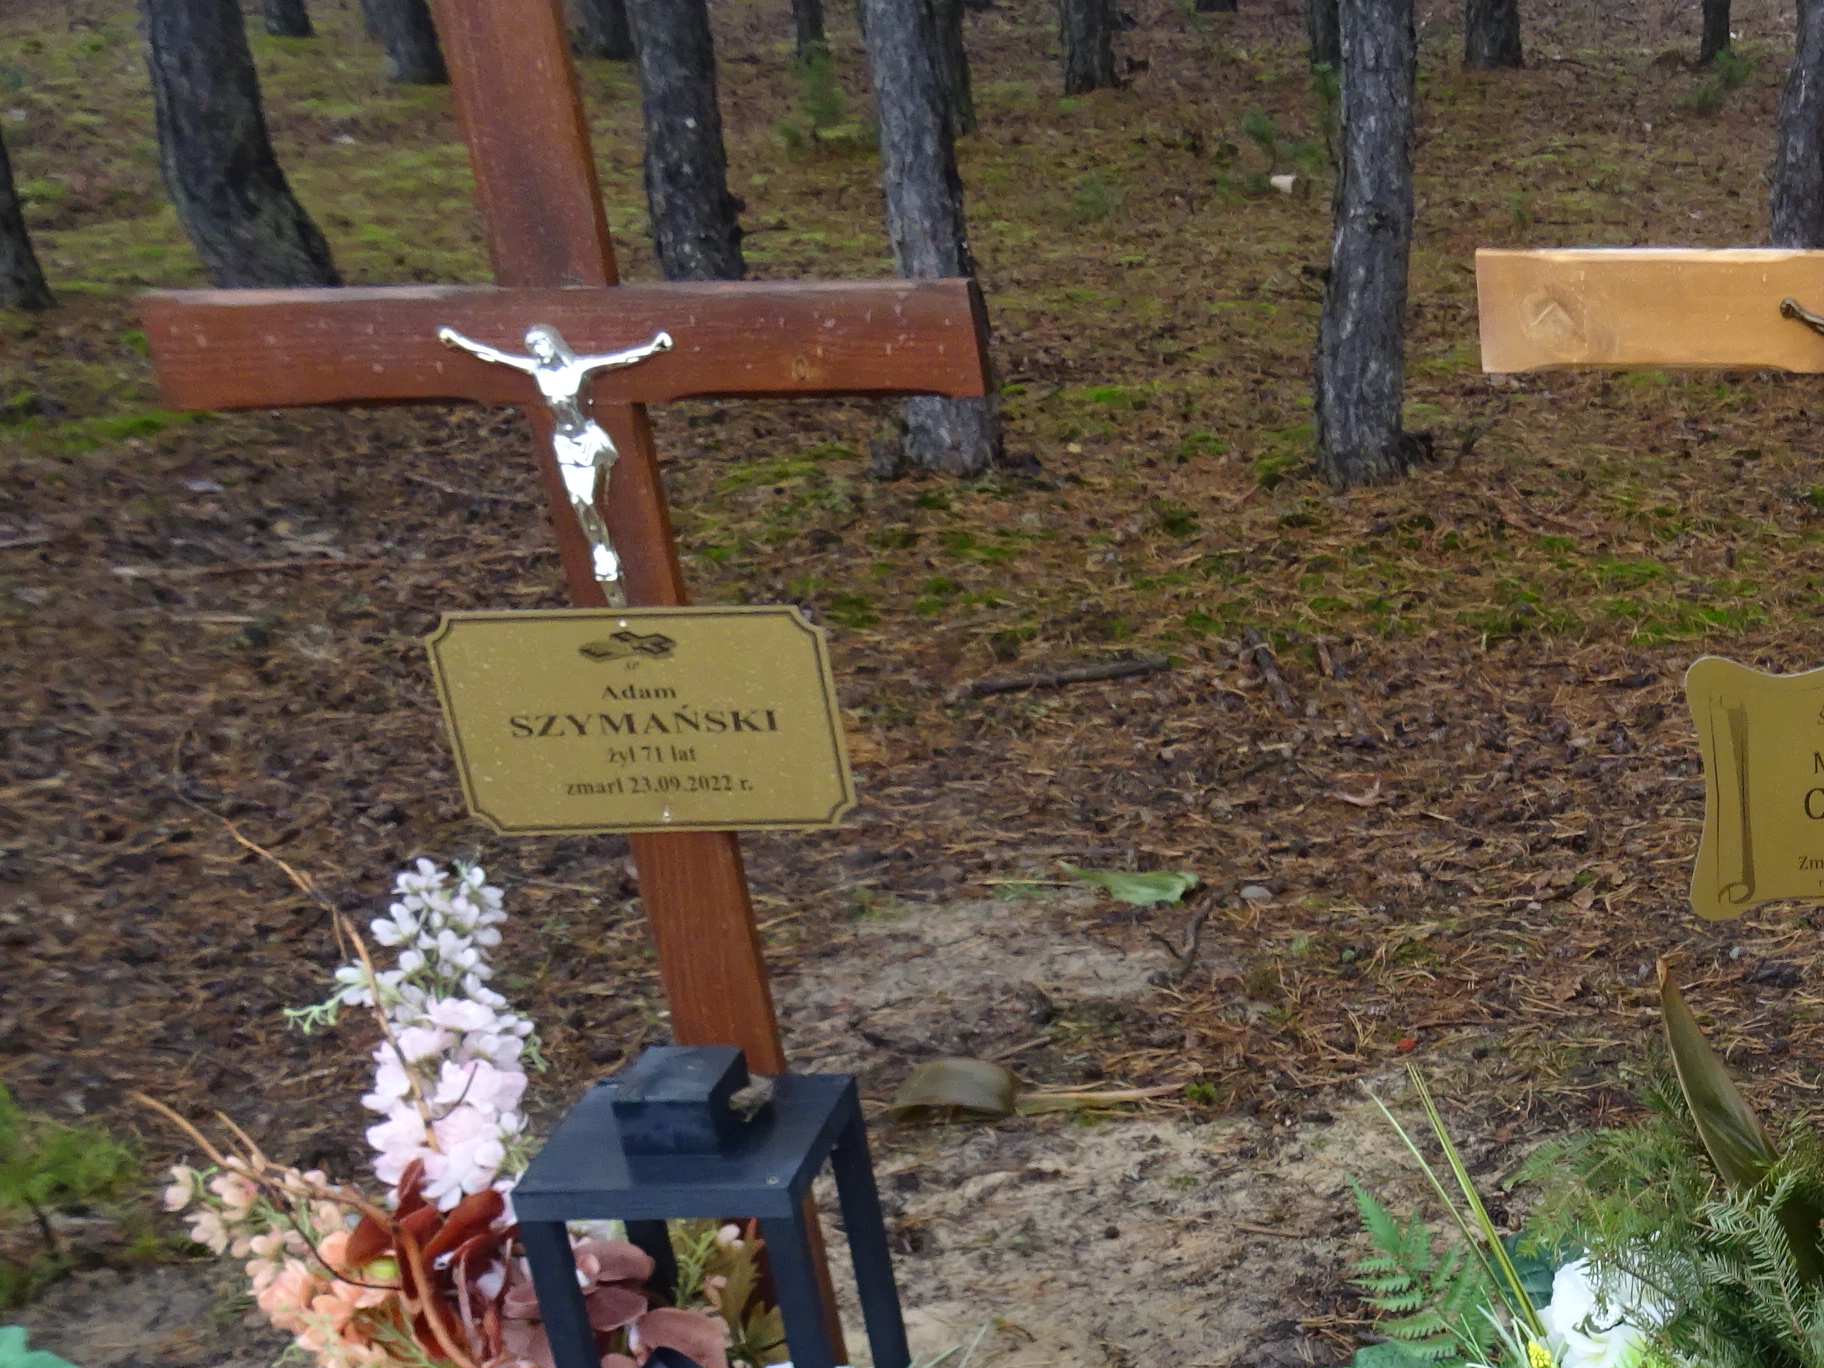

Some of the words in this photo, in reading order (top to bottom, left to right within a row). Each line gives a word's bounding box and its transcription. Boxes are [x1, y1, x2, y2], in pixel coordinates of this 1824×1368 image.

[601, 684, 678, 701] Adam
[508, 704, 782, 738] SZYMAŃSKI
[641, 745, 664, 764] 71
[671, 744, 696, 763] lat
